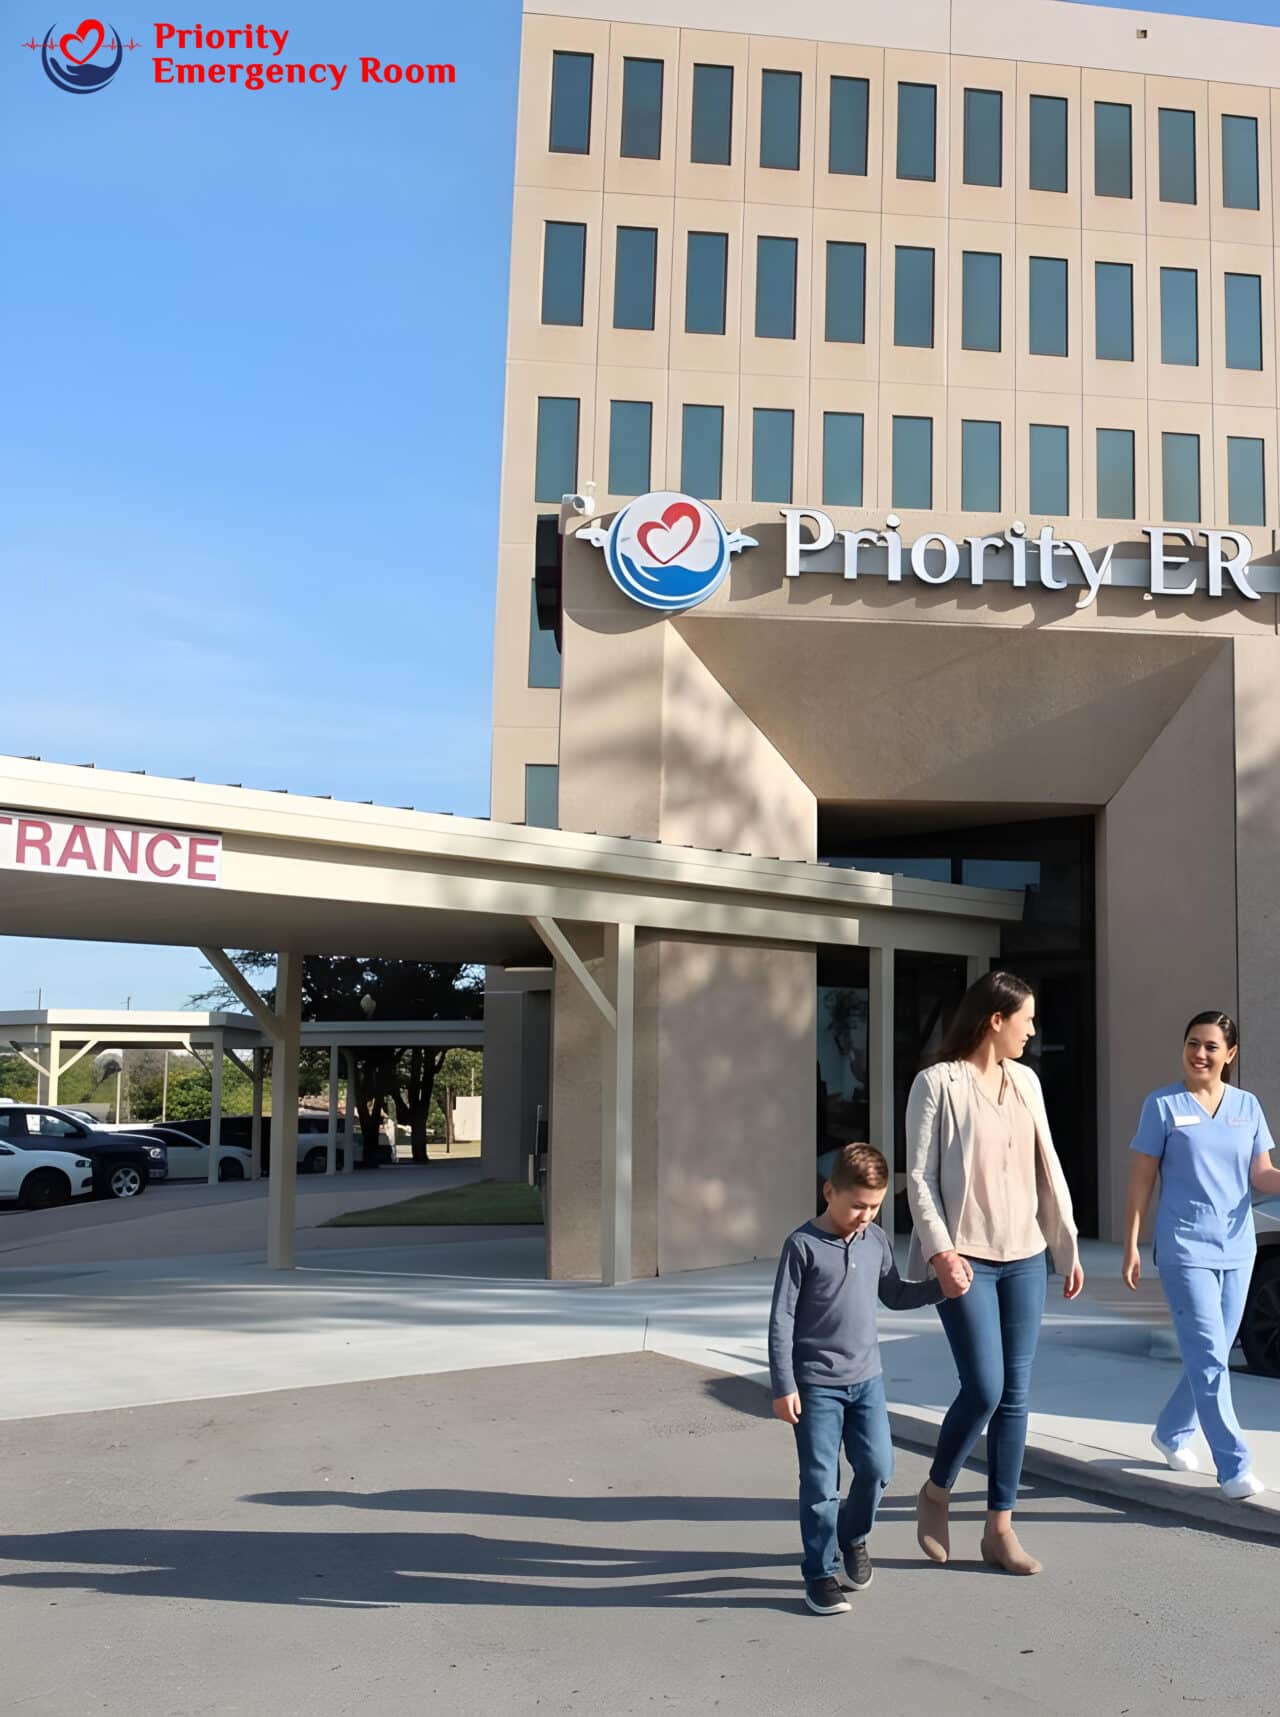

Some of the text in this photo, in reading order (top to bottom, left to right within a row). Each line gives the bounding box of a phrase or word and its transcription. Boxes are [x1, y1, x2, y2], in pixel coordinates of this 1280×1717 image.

[779, 507, 1113, 609] Priority
[1142, 525, 1262, 601] ER
[0, 816, 219, 881] RANCE
